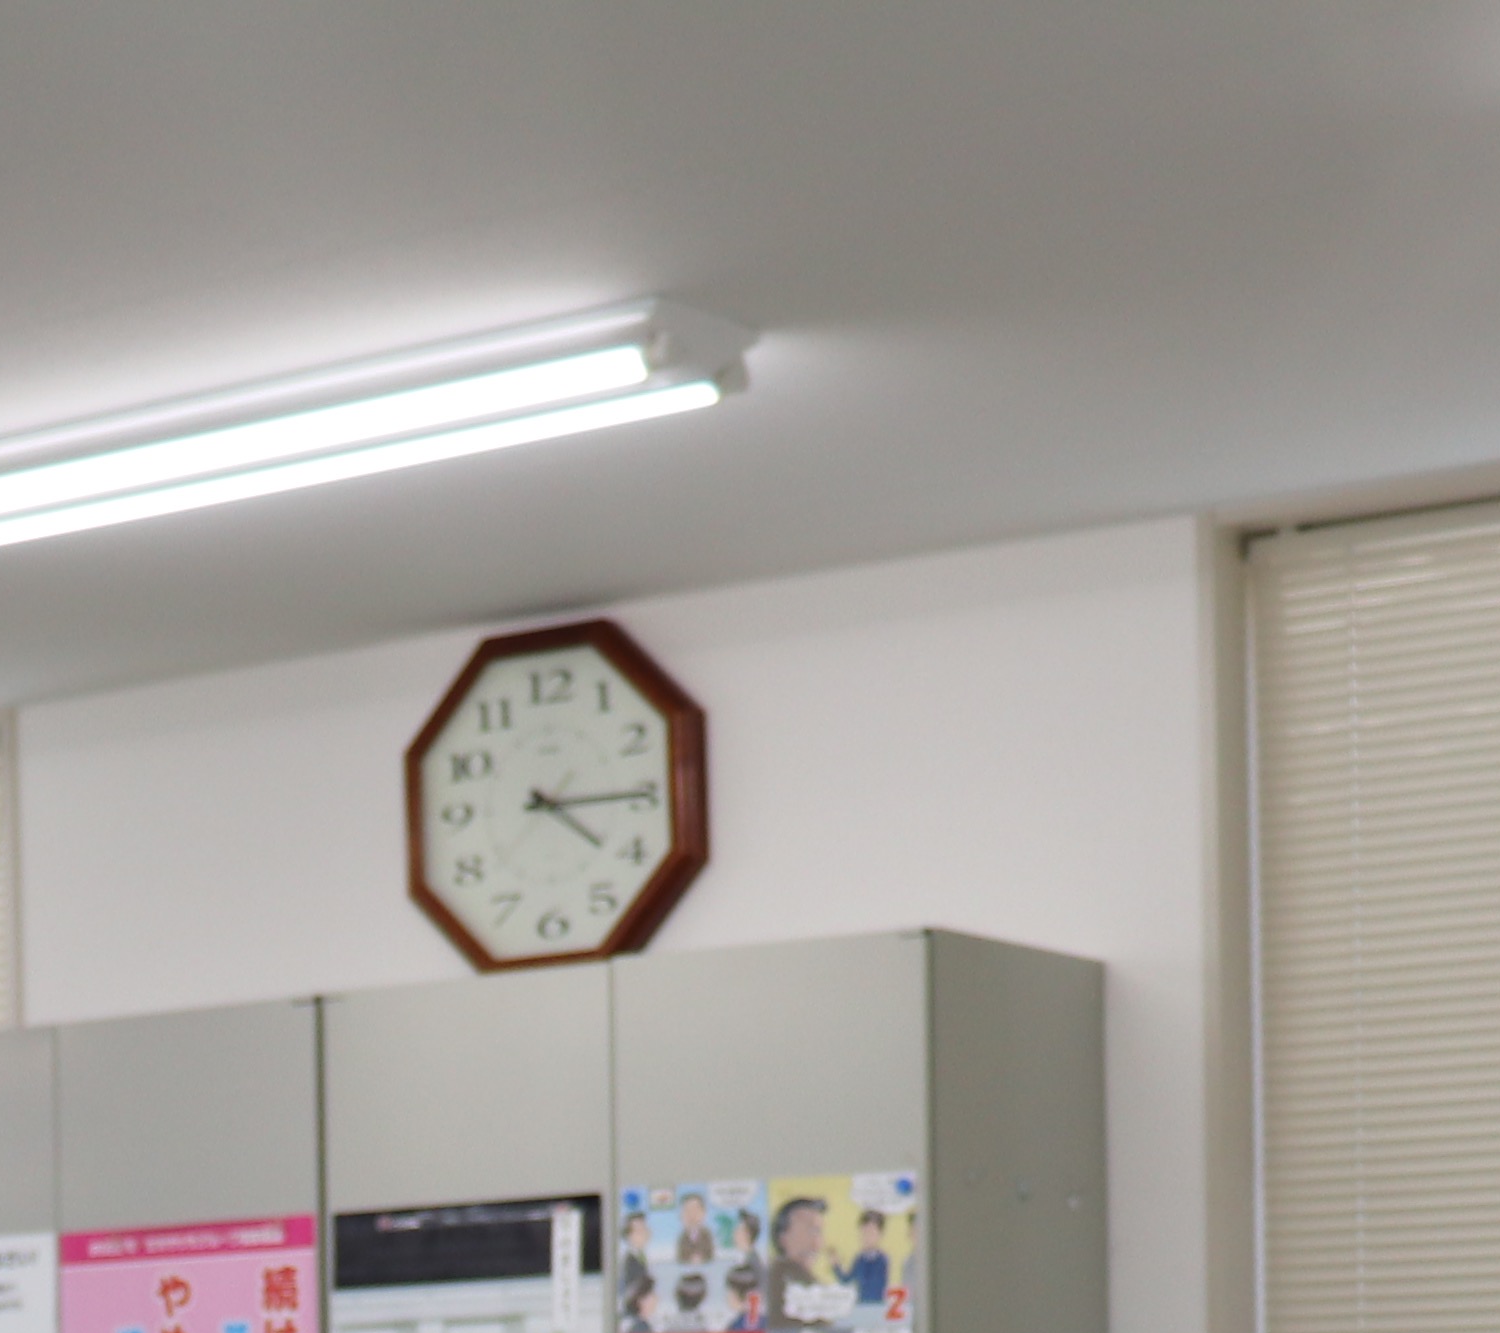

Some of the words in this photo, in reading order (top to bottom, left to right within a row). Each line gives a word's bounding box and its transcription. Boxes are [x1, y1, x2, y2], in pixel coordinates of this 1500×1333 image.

[527, 670, 574, 705] 12
[594, 681, 611, 712] 1
[479, 700, 511, 733] 11
[622, 724, 649, 757] 2
[452, 751, 492, 781] 10
[631, 783, 659, 810] 3
[441, 803, 473, 828] 9
[617, 837, 645, 864] 4
[455, 855, 483, 886] 8
[492, 894, 521, 927] 7
[590, 883, 616, 915] 5
[538, 911, 568, 939] 6
[746, 1292, 760, 1326] 1
[885, 1288, 909, 1321] 2
